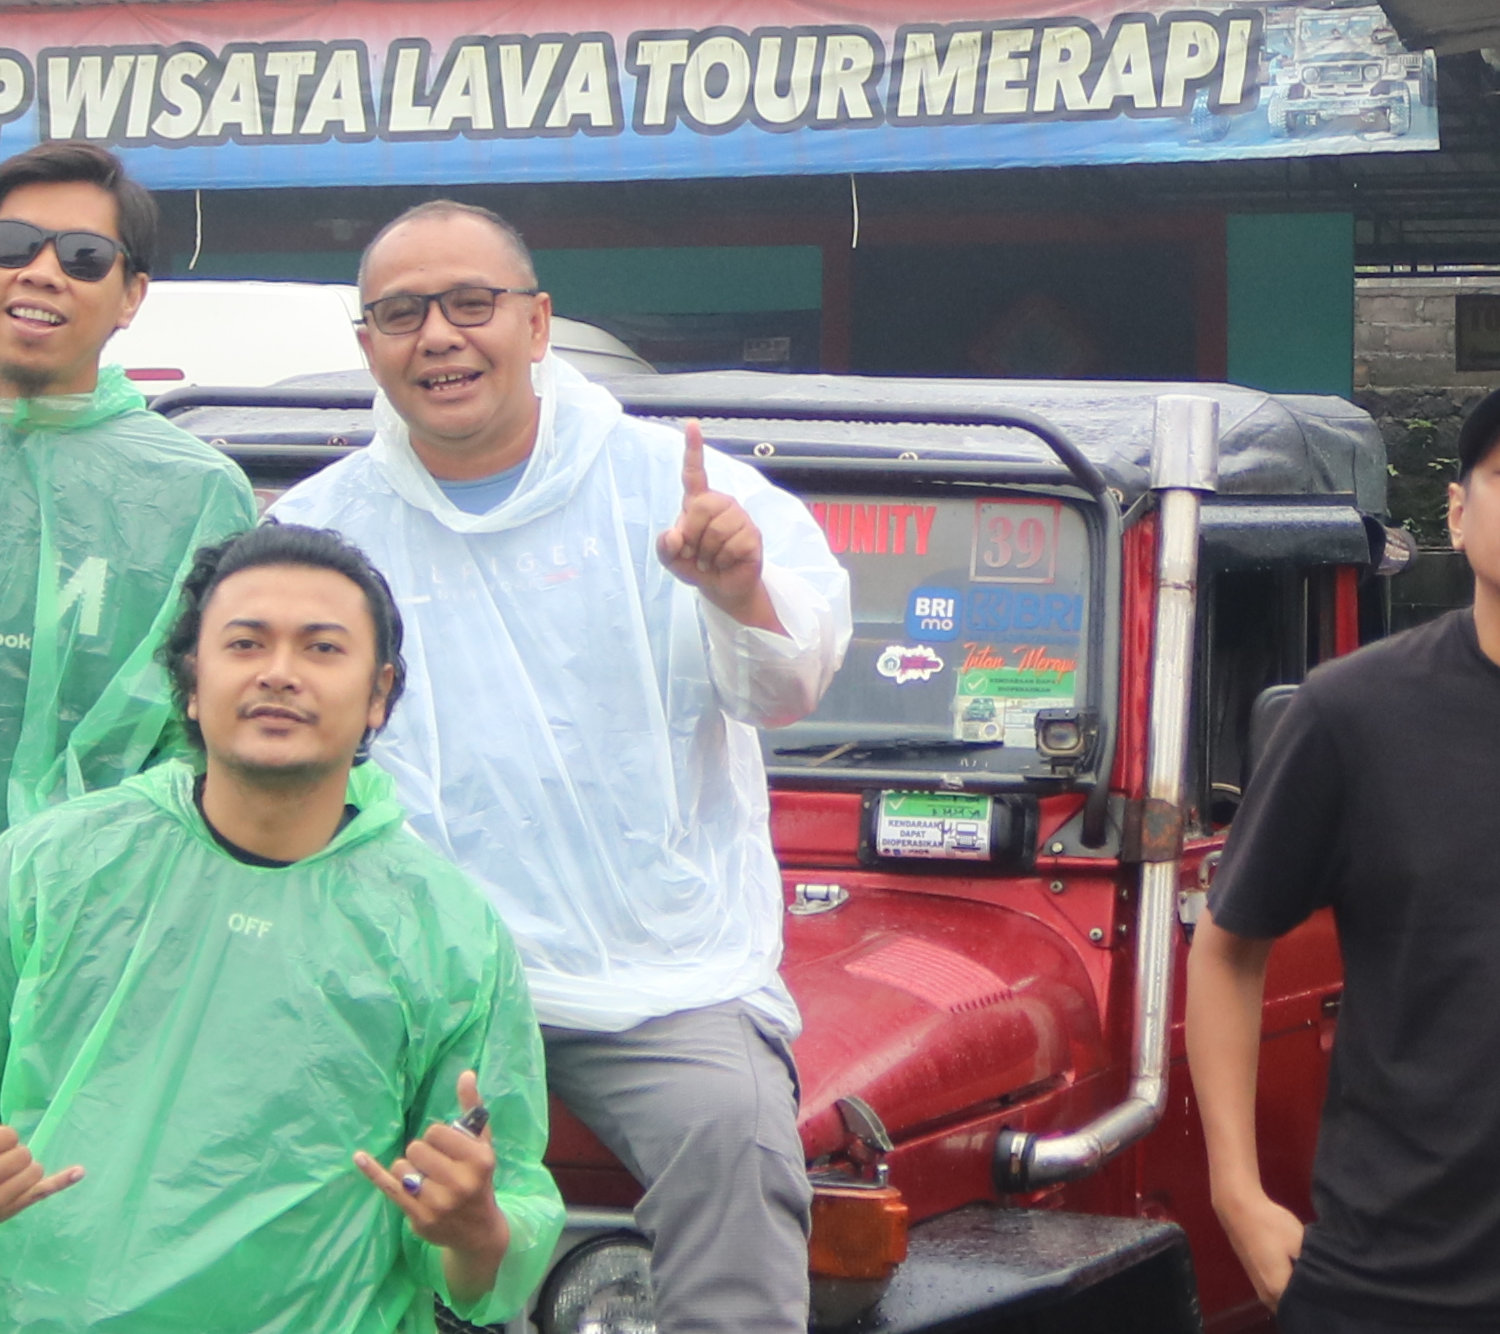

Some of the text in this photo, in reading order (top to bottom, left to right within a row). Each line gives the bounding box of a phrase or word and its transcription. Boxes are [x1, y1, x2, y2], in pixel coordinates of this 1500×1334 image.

[44, 44, 372, 143] WISATA
[381, 40, 604, 134] LAVA
[633, 32, 884, 127] TOUR
[897, 18, 1255, 119] MERAPI
[983, 516, 1046, 569] 39
[915, 597, 954, 617] BRI
[1013, 594, 1083, 632] BRI
[921, 619, 953, 631] mo
[888, 819, 942, 829] KENDARAAN
[900, 830, 927, 838] DAPAT
[882, 838, 943, 847] DIOPERASIKAN
[228, 913, 273, 938] OFF
